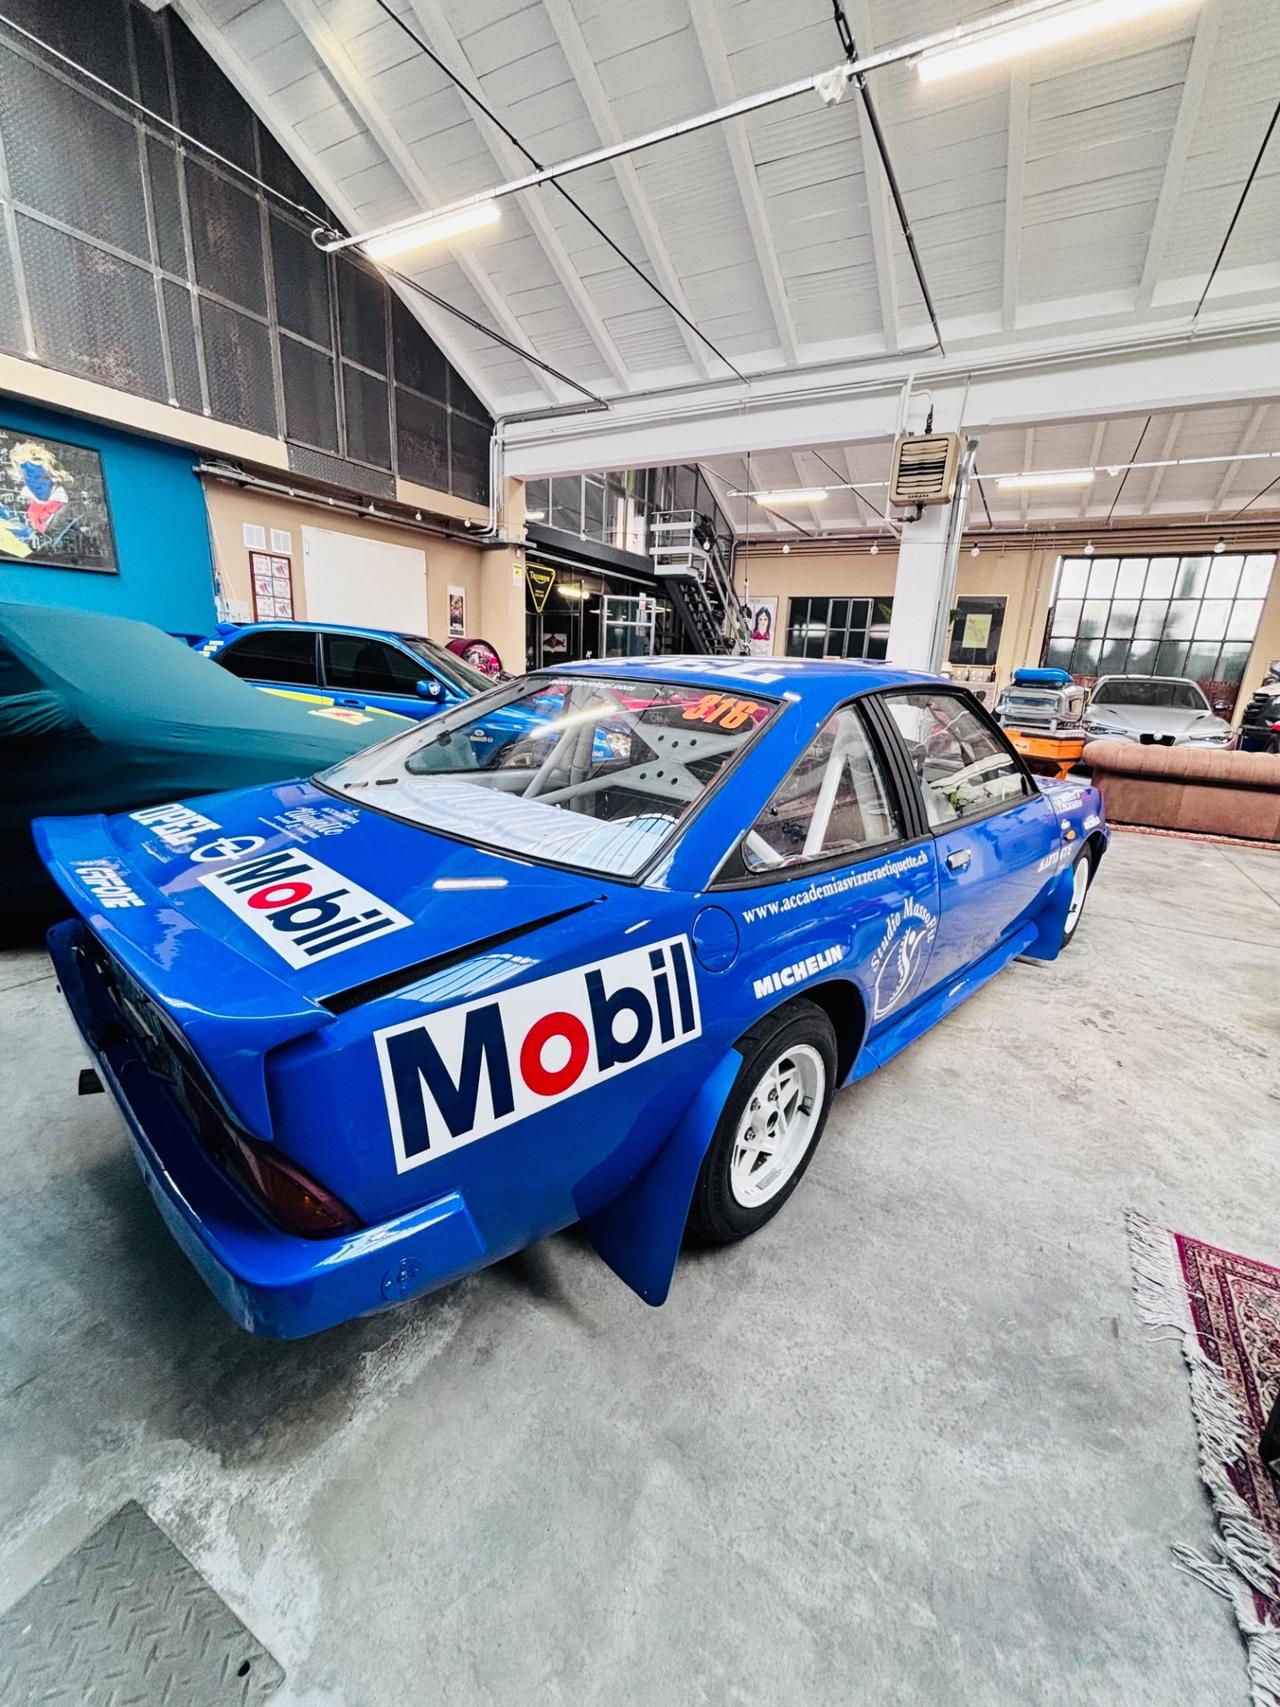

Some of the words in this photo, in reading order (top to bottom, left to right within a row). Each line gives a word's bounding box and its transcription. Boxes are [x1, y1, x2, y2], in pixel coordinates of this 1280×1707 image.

[128, 803, 223, 846] OPEL
[216, 853, 395, 956] Mobil
[742, 850, 929, 924] www.accademiasvizzeraetiquette.ch
[753, 944, 844, 1000] MICHELIN
[871, 912, 901, 972] Studio
[385, 942, 697, 1160] Mobil
